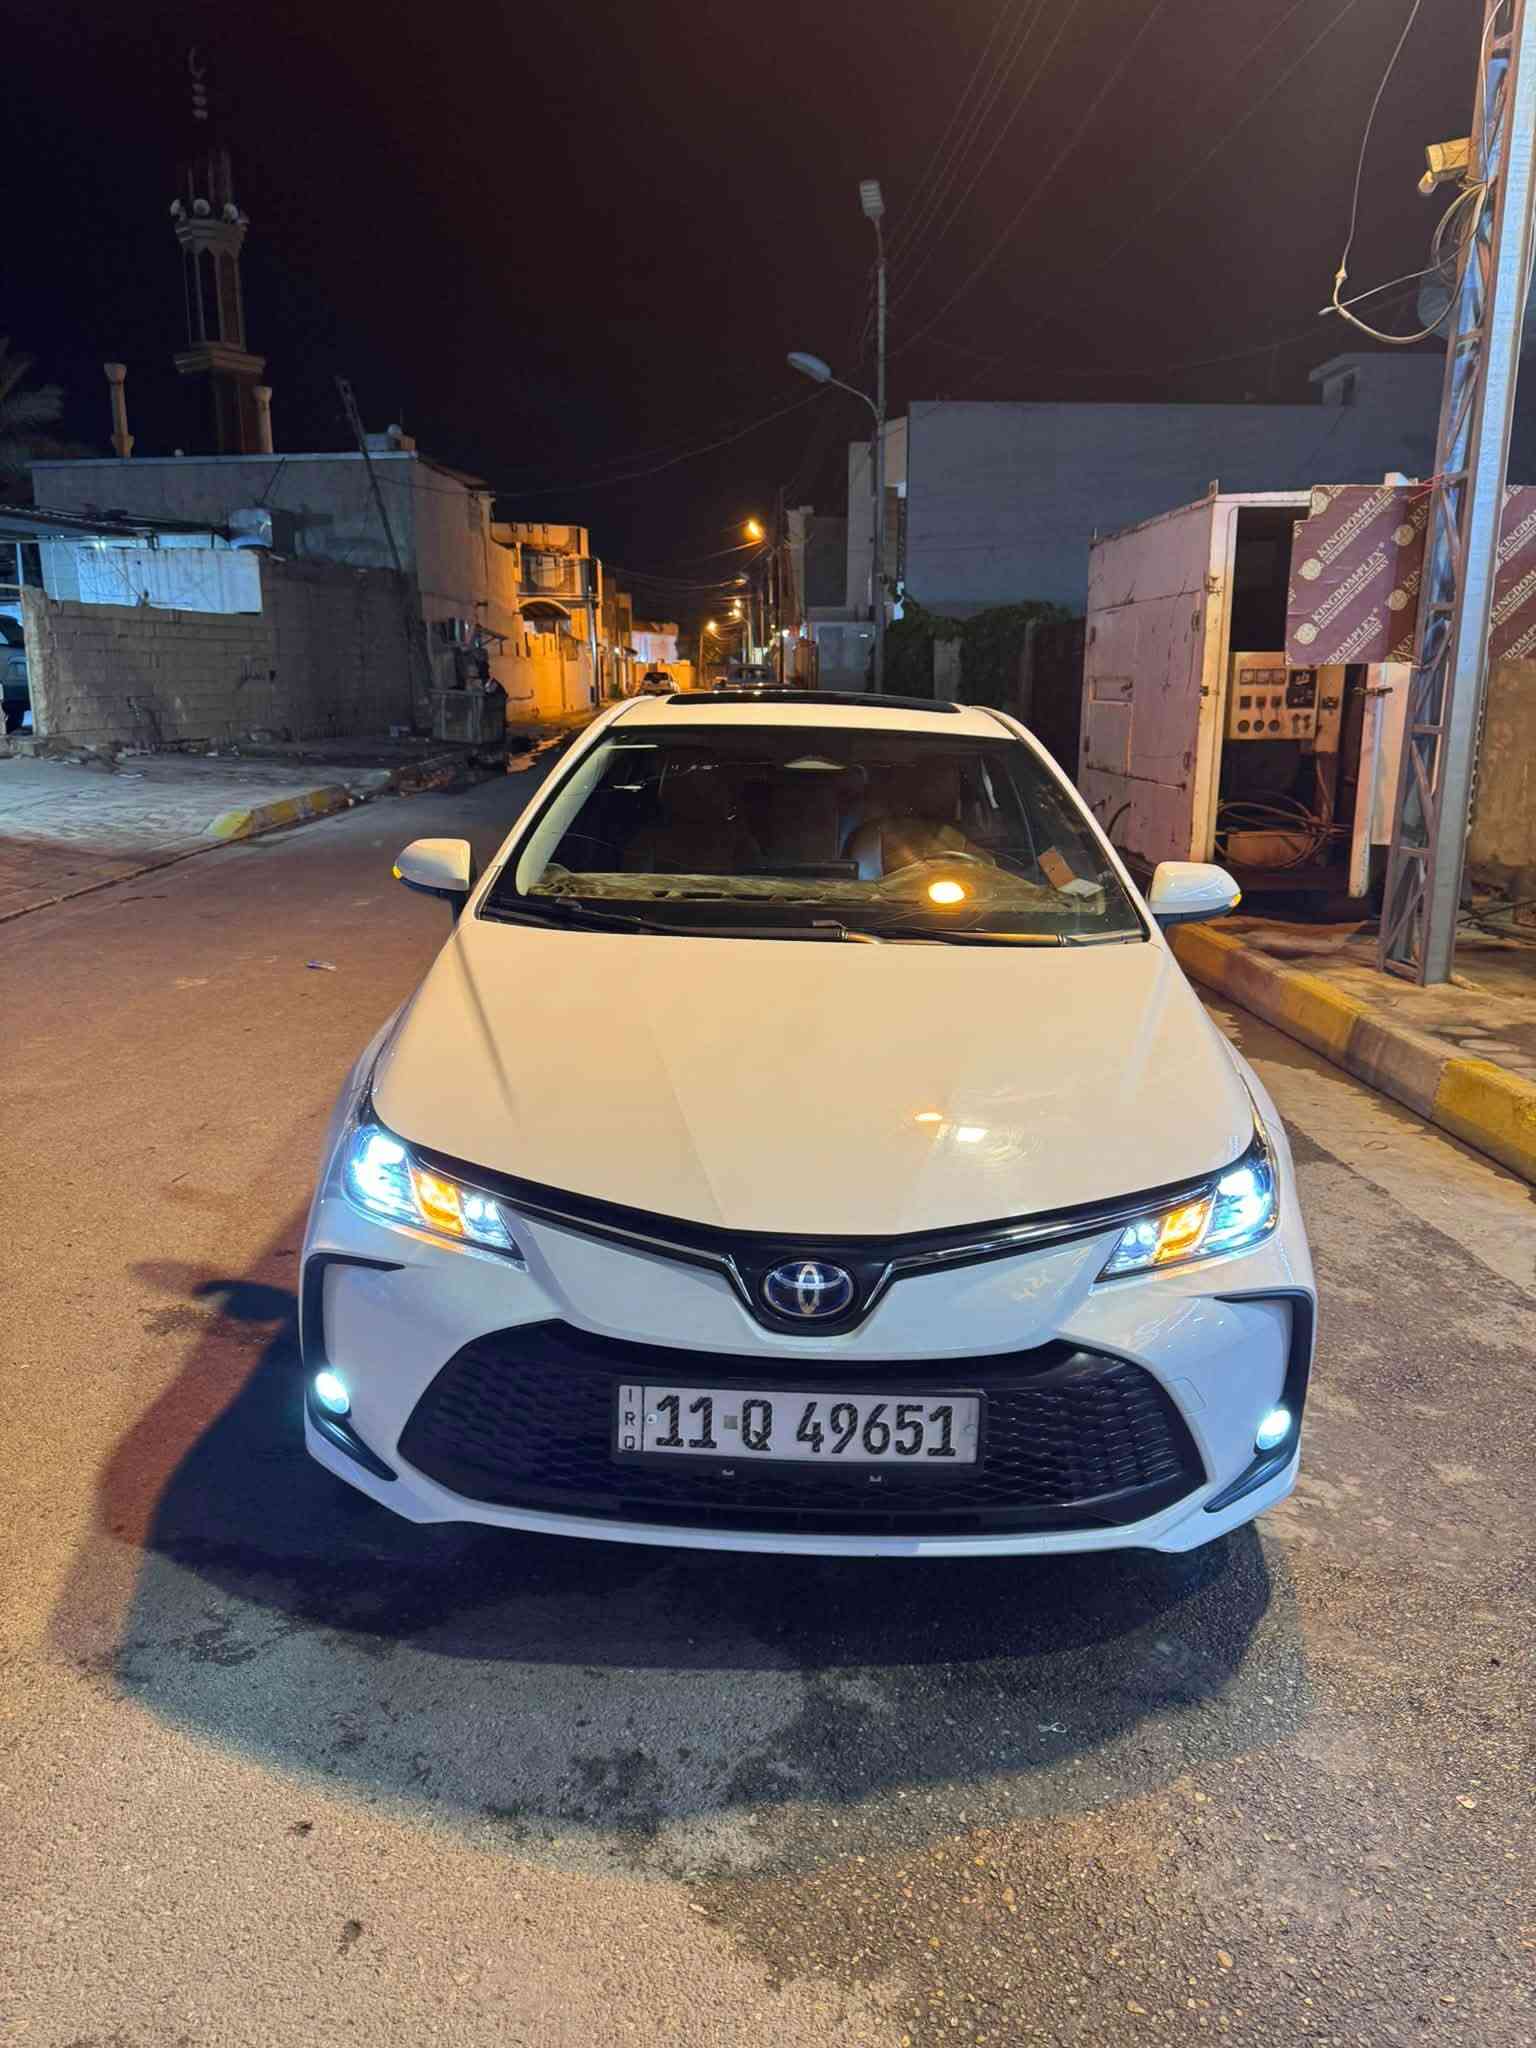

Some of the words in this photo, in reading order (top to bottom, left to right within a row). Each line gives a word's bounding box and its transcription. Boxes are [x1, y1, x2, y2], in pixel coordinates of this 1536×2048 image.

[624, 1388, 636, 1449] IRQ
[656, 1394, 717, 1449] 11
[741, 1399, 772, 1452] Q
[796, 1401, 957, 1457] 49651
